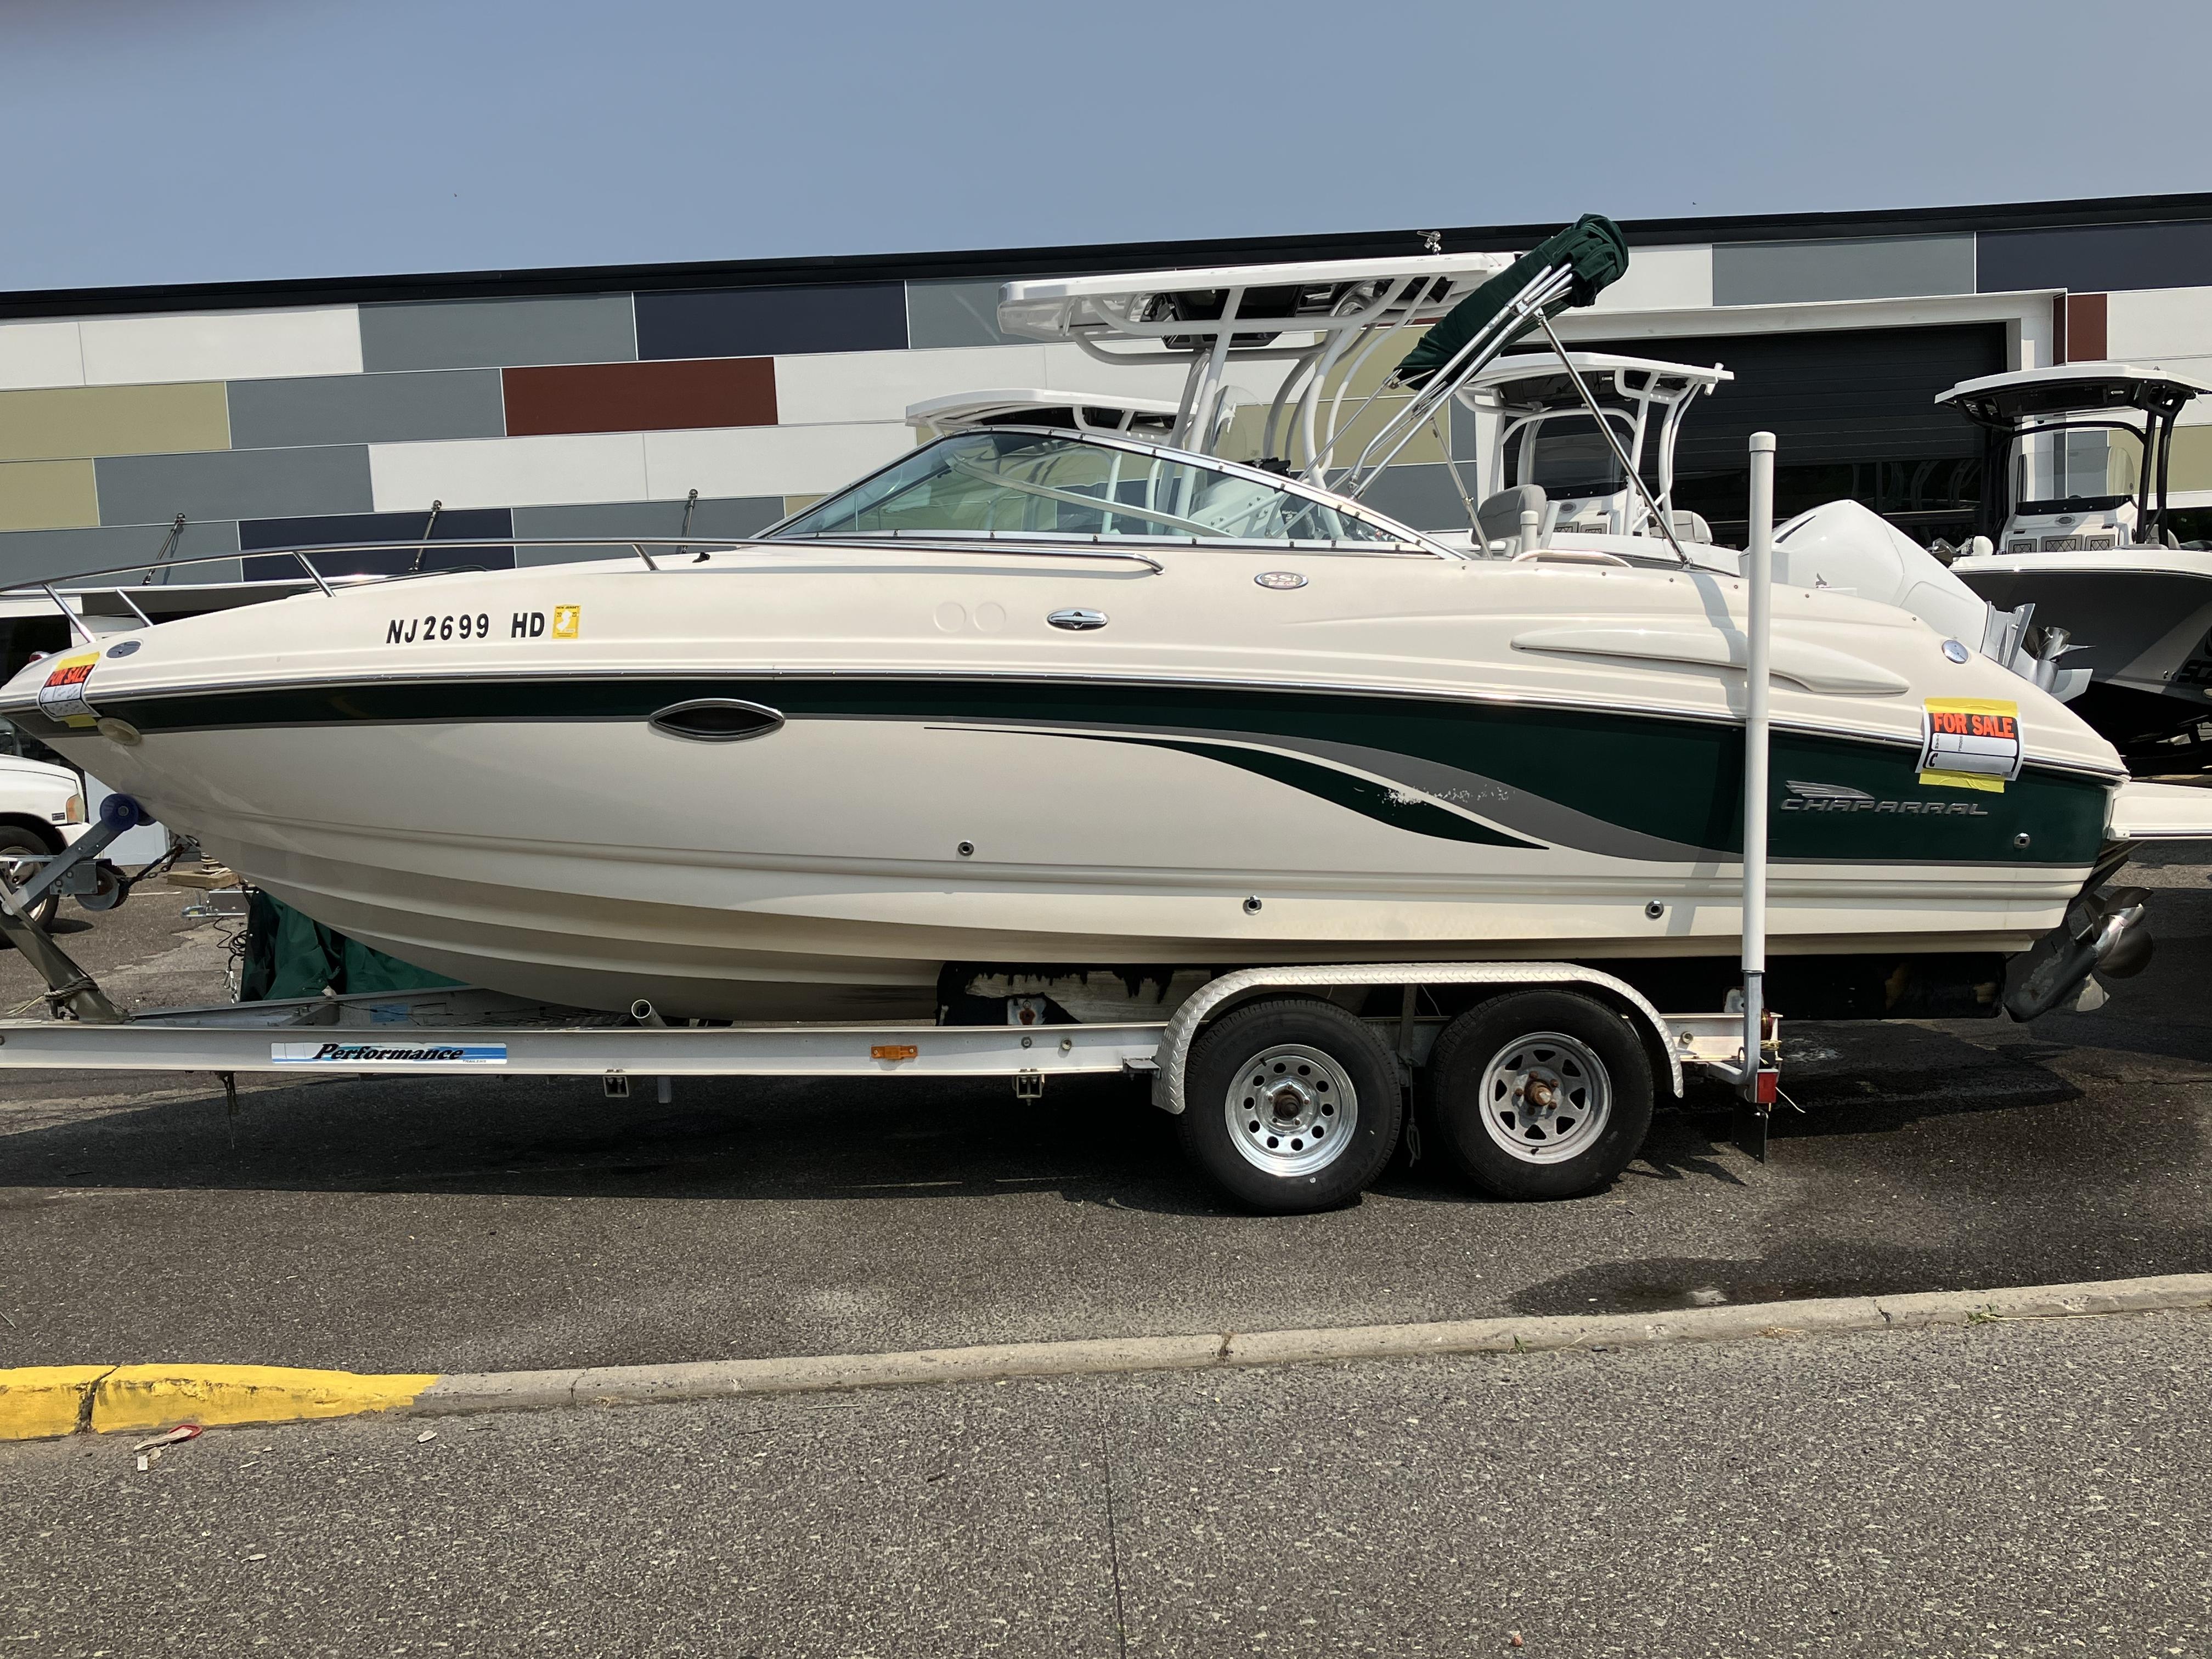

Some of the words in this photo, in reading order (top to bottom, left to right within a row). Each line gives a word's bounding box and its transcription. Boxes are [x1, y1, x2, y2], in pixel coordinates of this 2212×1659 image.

[511, 612, 544, 638] HD
[45, 668, 67, 686] FOR
[64, 665, 94, 684] SALE
[1933, 713, 1967, 734] FOR
[1972, 715, 2015, 738] SALE
[1780, 799, 1988, 815] CHAPARRAL
[312, 1043, 464, 1060] Performance
